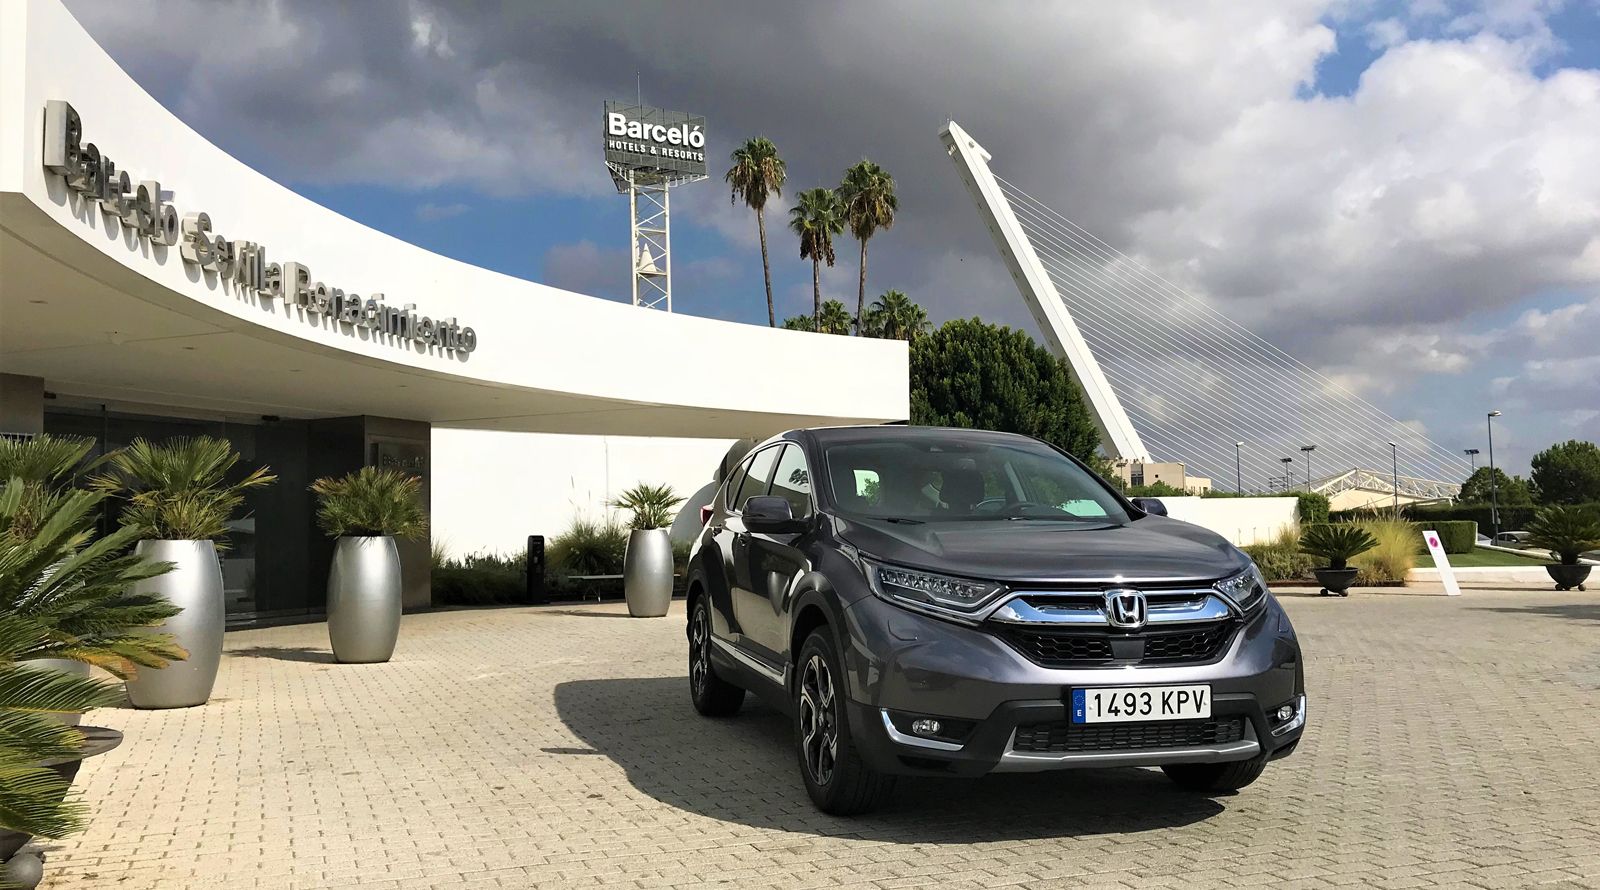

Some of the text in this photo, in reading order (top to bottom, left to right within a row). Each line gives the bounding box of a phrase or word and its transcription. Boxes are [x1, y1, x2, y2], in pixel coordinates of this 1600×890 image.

[608, 112, 705, 148] Barceló
[609, 139, 704, 162] HOTELS & RESORTS
[180, 211, 284, 299] Sevilla
[284, 261, 477, 353] Renacimiento
[1076, 689, 1205, 717] E 1493 KPV
